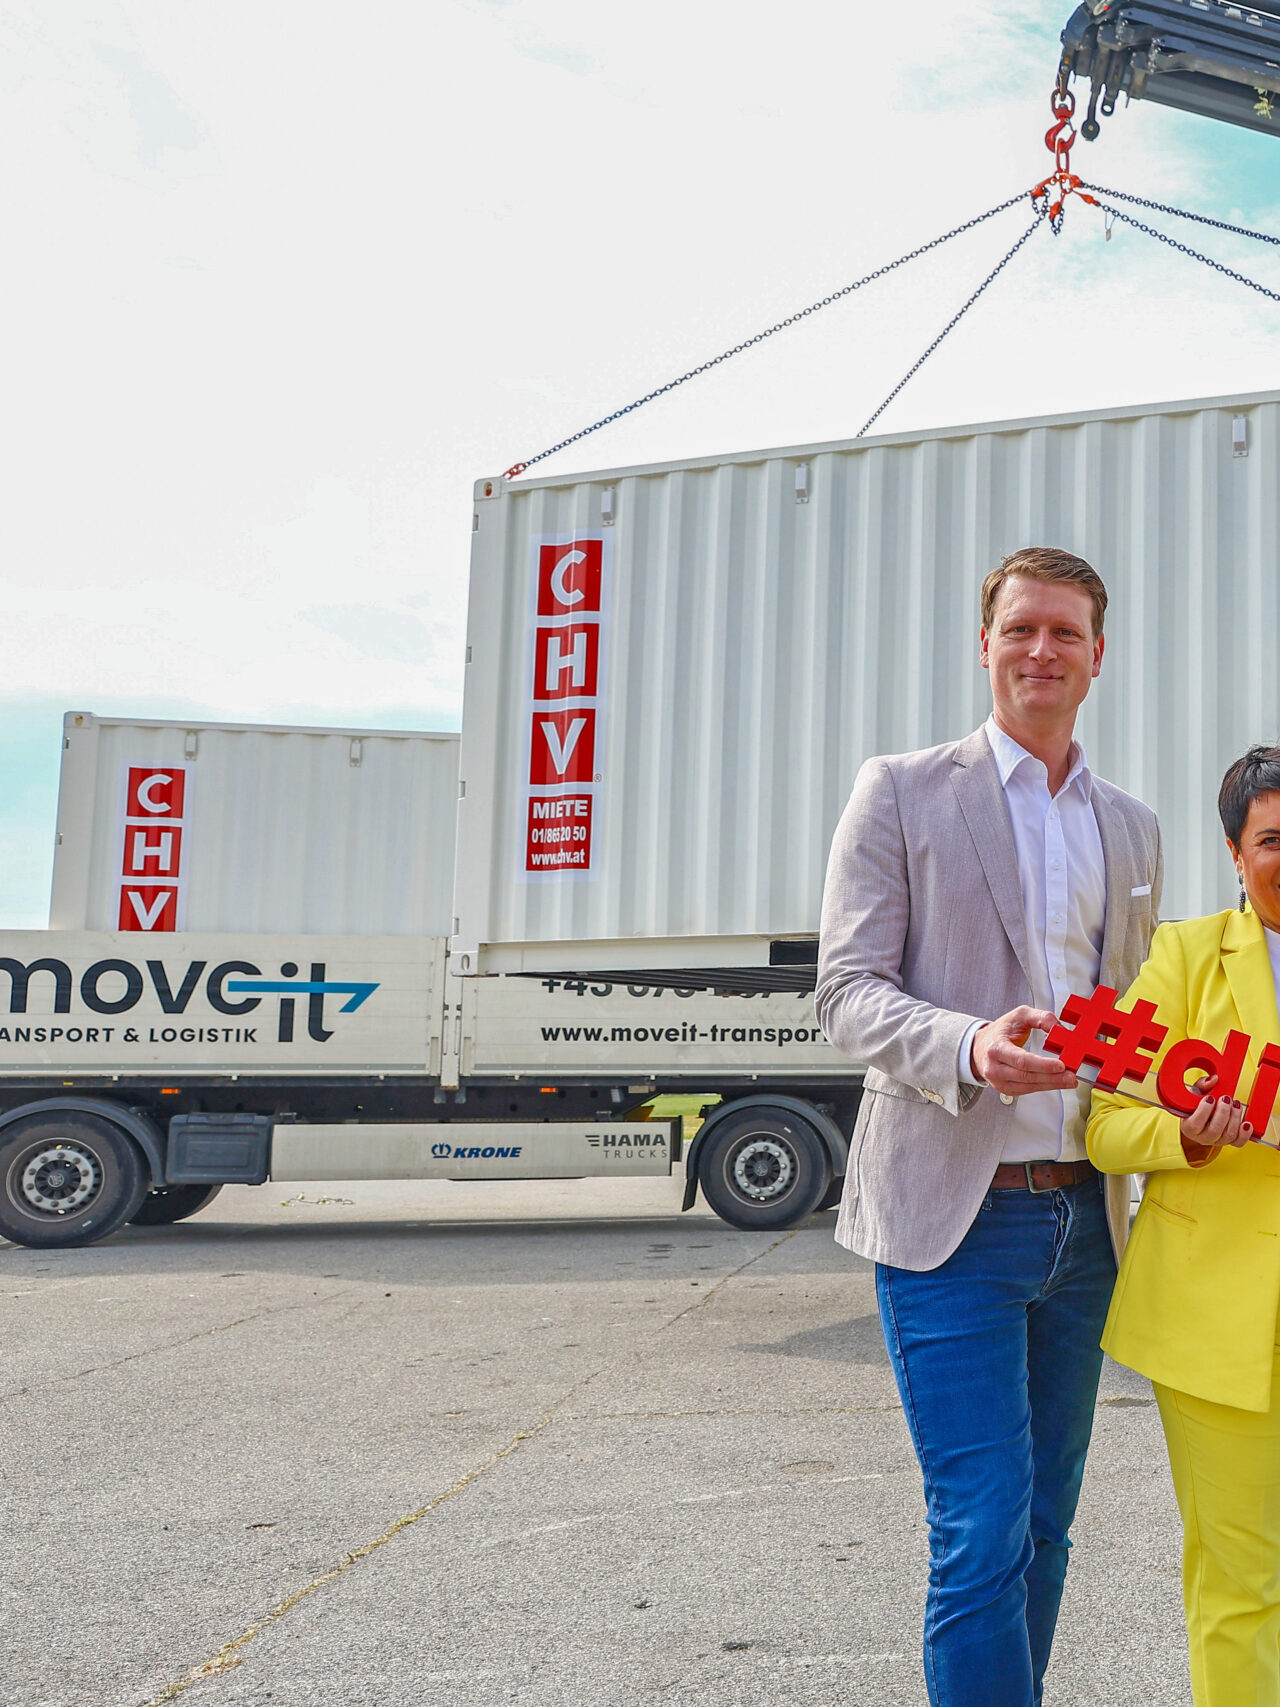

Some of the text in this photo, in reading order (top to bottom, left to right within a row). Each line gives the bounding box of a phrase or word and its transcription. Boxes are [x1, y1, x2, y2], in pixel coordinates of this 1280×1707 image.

[532, 800, 588, 819] MIETE
[123, 1028, 140, 1042] &
[149, 1028, 257, 1042] LOGISTIK
[541, 1022, 828, 1046] www.moveit-transpor
[603, 1134, 666, 1147] HAMA
[453, 1147, 522, 1158] KRONE
[604, 1150, 668, 1159] TRUCKS
